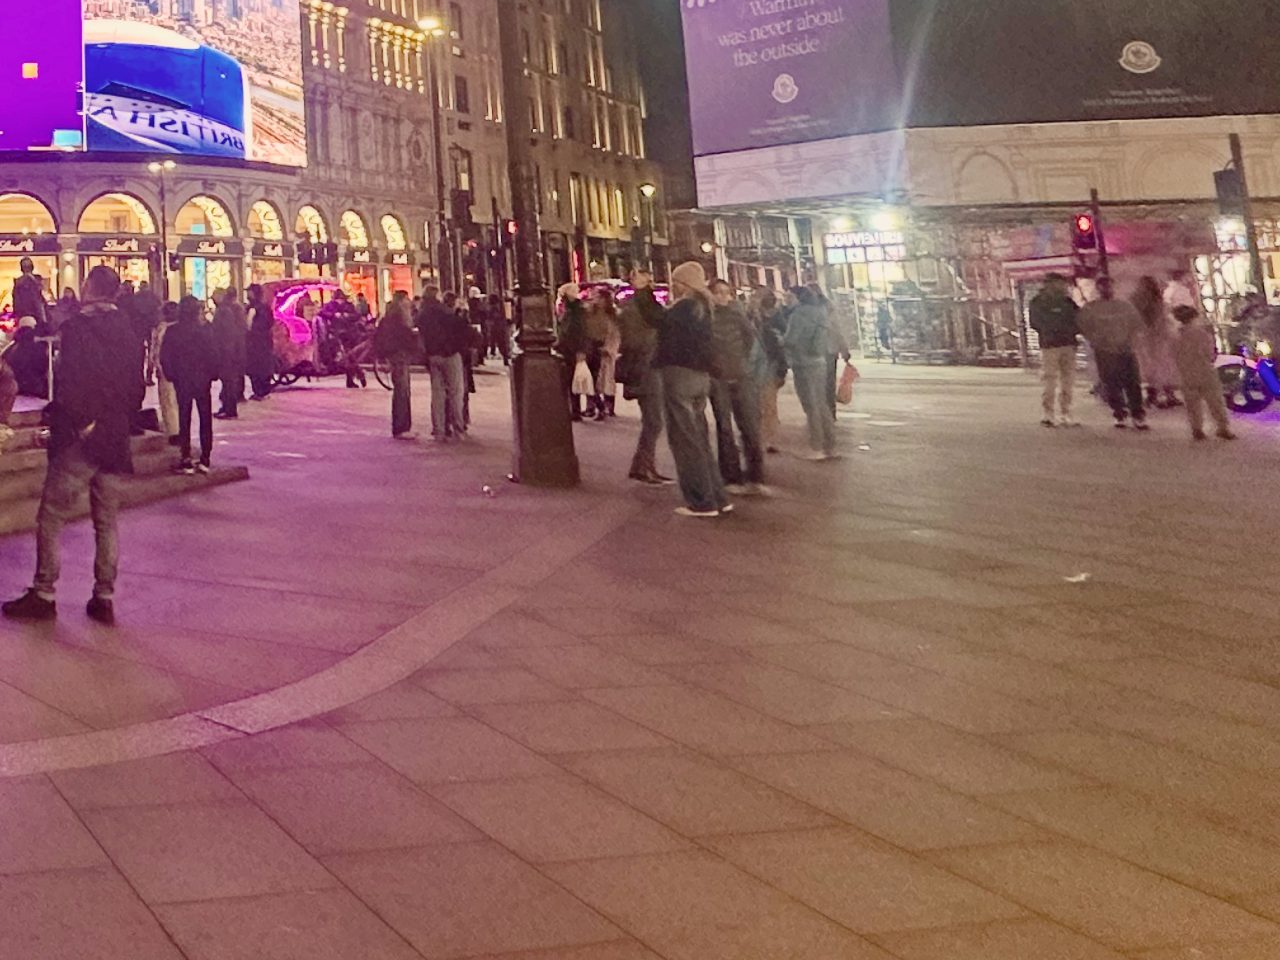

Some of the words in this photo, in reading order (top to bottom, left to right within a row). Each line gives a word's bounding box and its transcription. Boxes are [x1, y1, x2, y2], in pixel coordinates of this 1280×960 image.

[718, 31, 747, 47] was
[750, 18, 794, 41] never
[796, 5, 845, 31] about
[733, 47, 759, 67] the
[760, 34, 819, 61] outside
